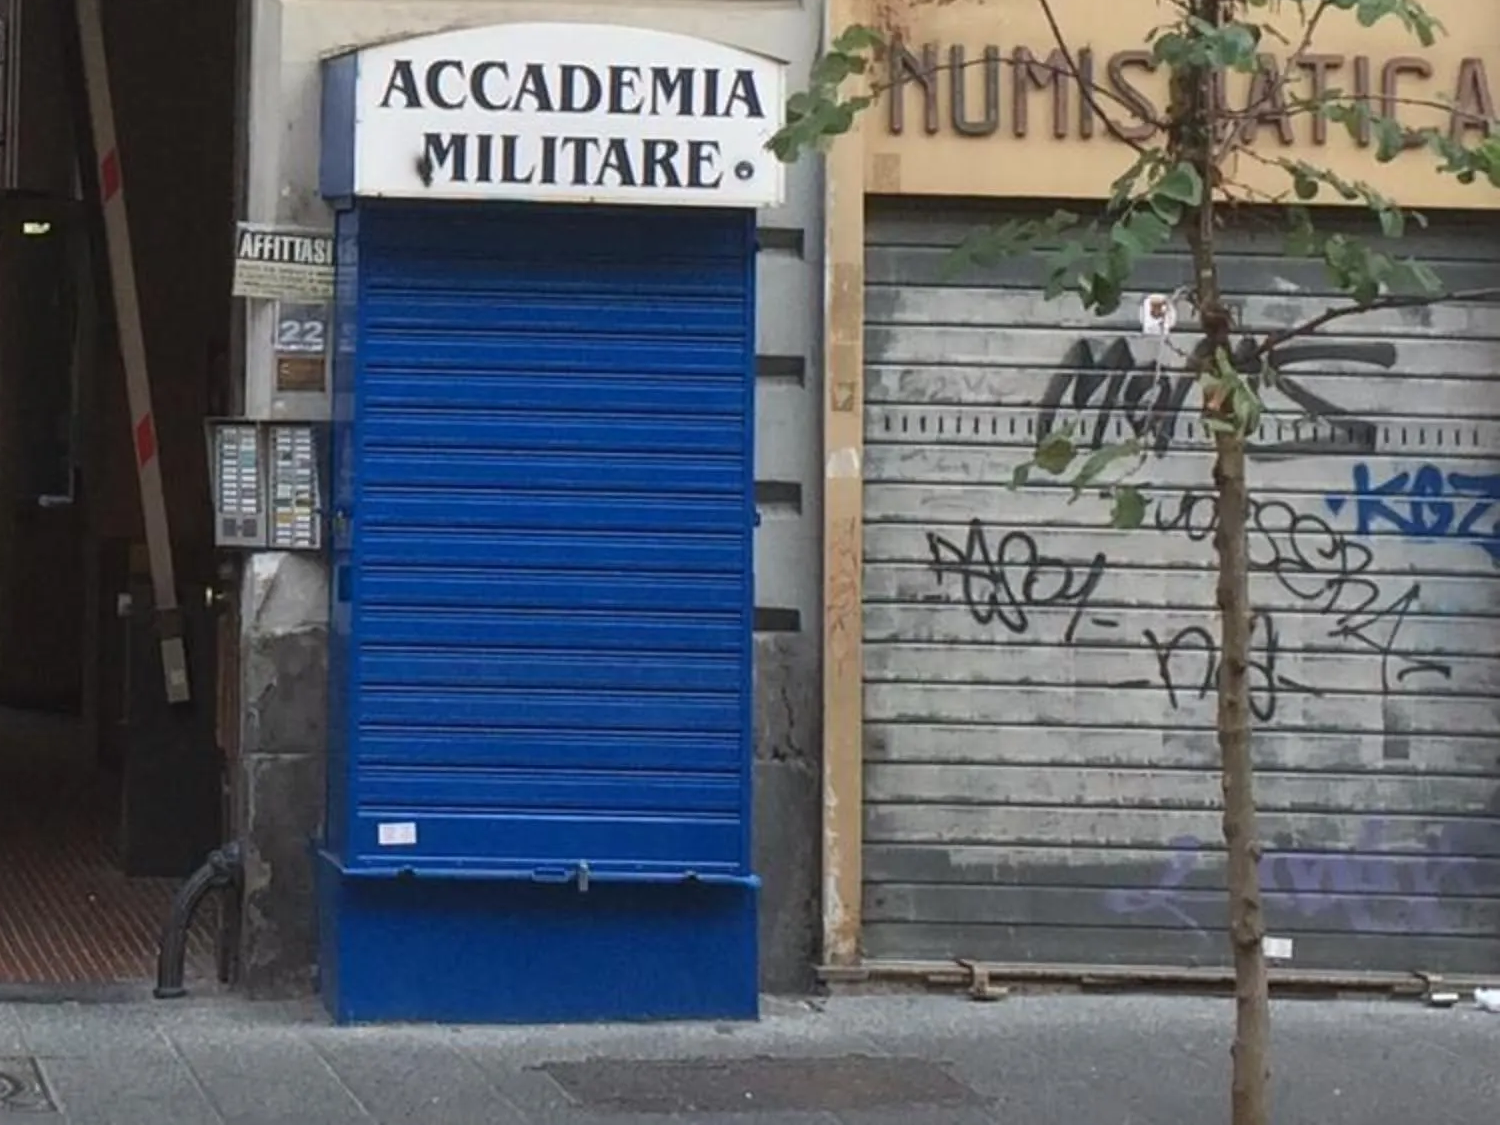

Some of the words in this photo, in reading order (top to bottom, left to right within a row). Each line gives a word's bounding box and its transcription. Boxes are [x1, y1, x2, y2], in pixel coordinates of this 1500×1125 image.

[379, 60, 766, 119] ACCADEMIA
[888, 40, 1497, 150] NUMISATICA
[422, 132, 722, 188] MILITARE
[239, 232, 334, 264] AFFITTASI
[280, 320, 324, 343] 22
